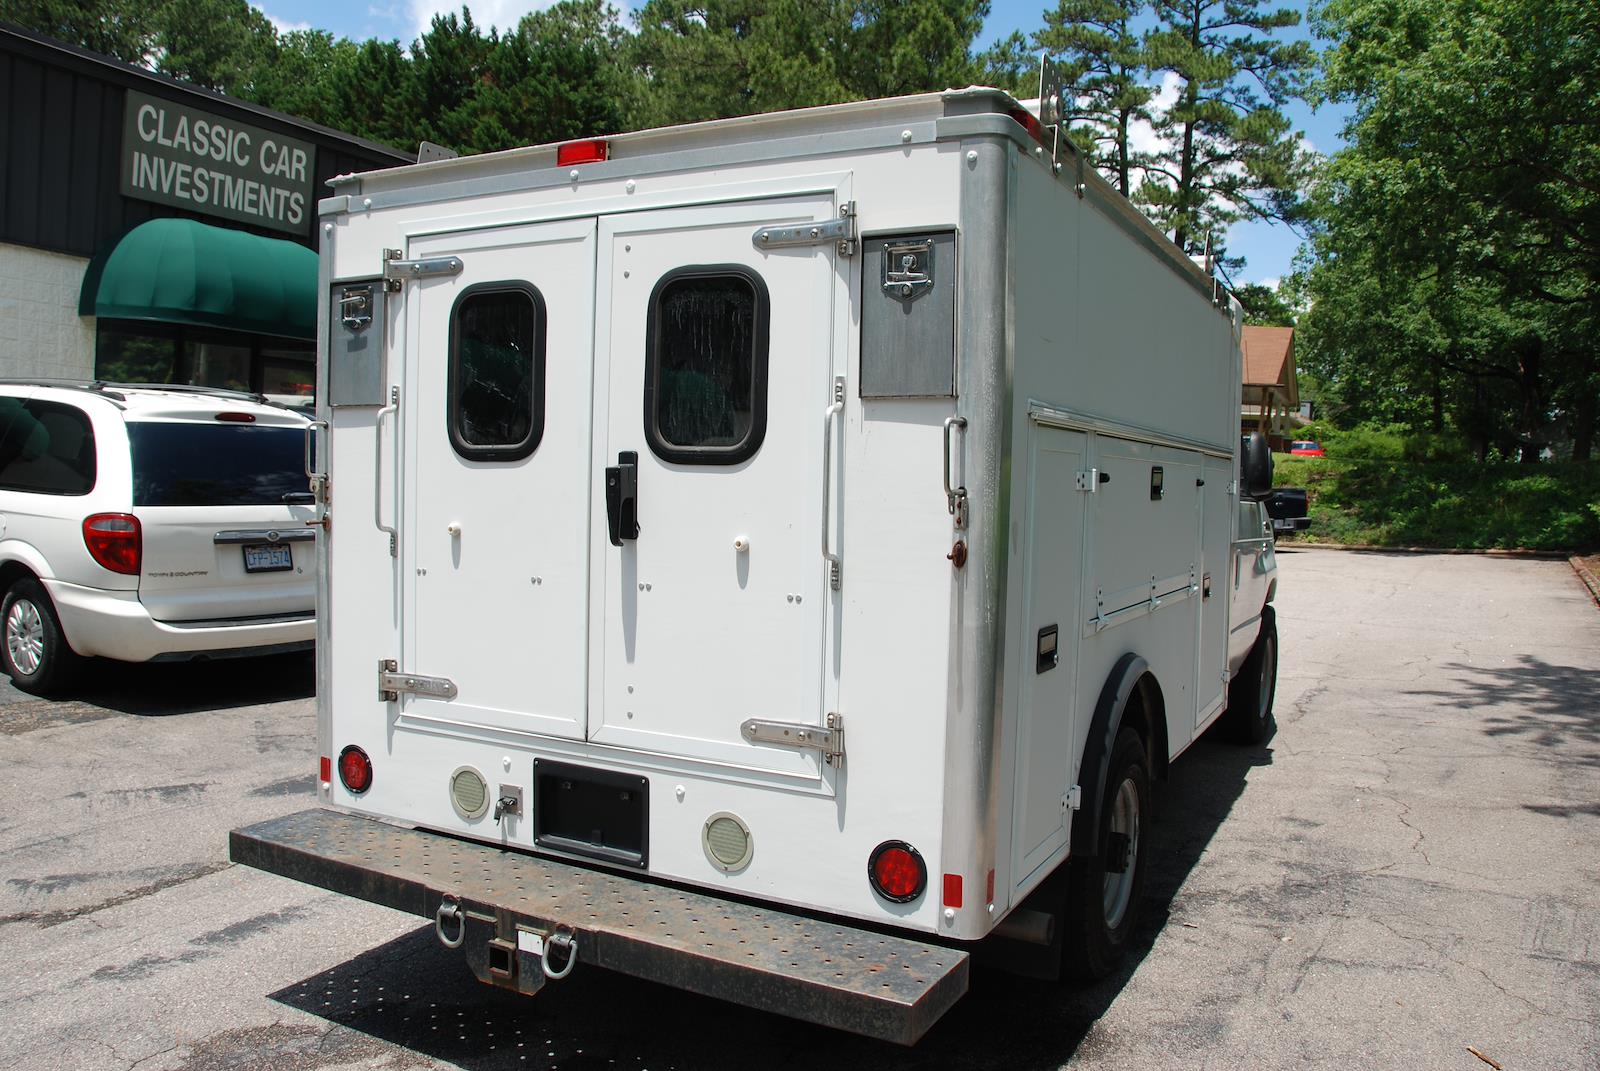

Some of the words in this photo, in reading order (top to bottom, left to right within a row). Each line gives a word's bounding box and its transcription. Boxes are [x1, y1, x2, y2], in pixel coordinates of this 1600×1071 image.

[137, 103, 251, 167] CLASSIC
[260, 140, 307, 183] CAR
[132, 151, 305, 225] INVESTMENTS
